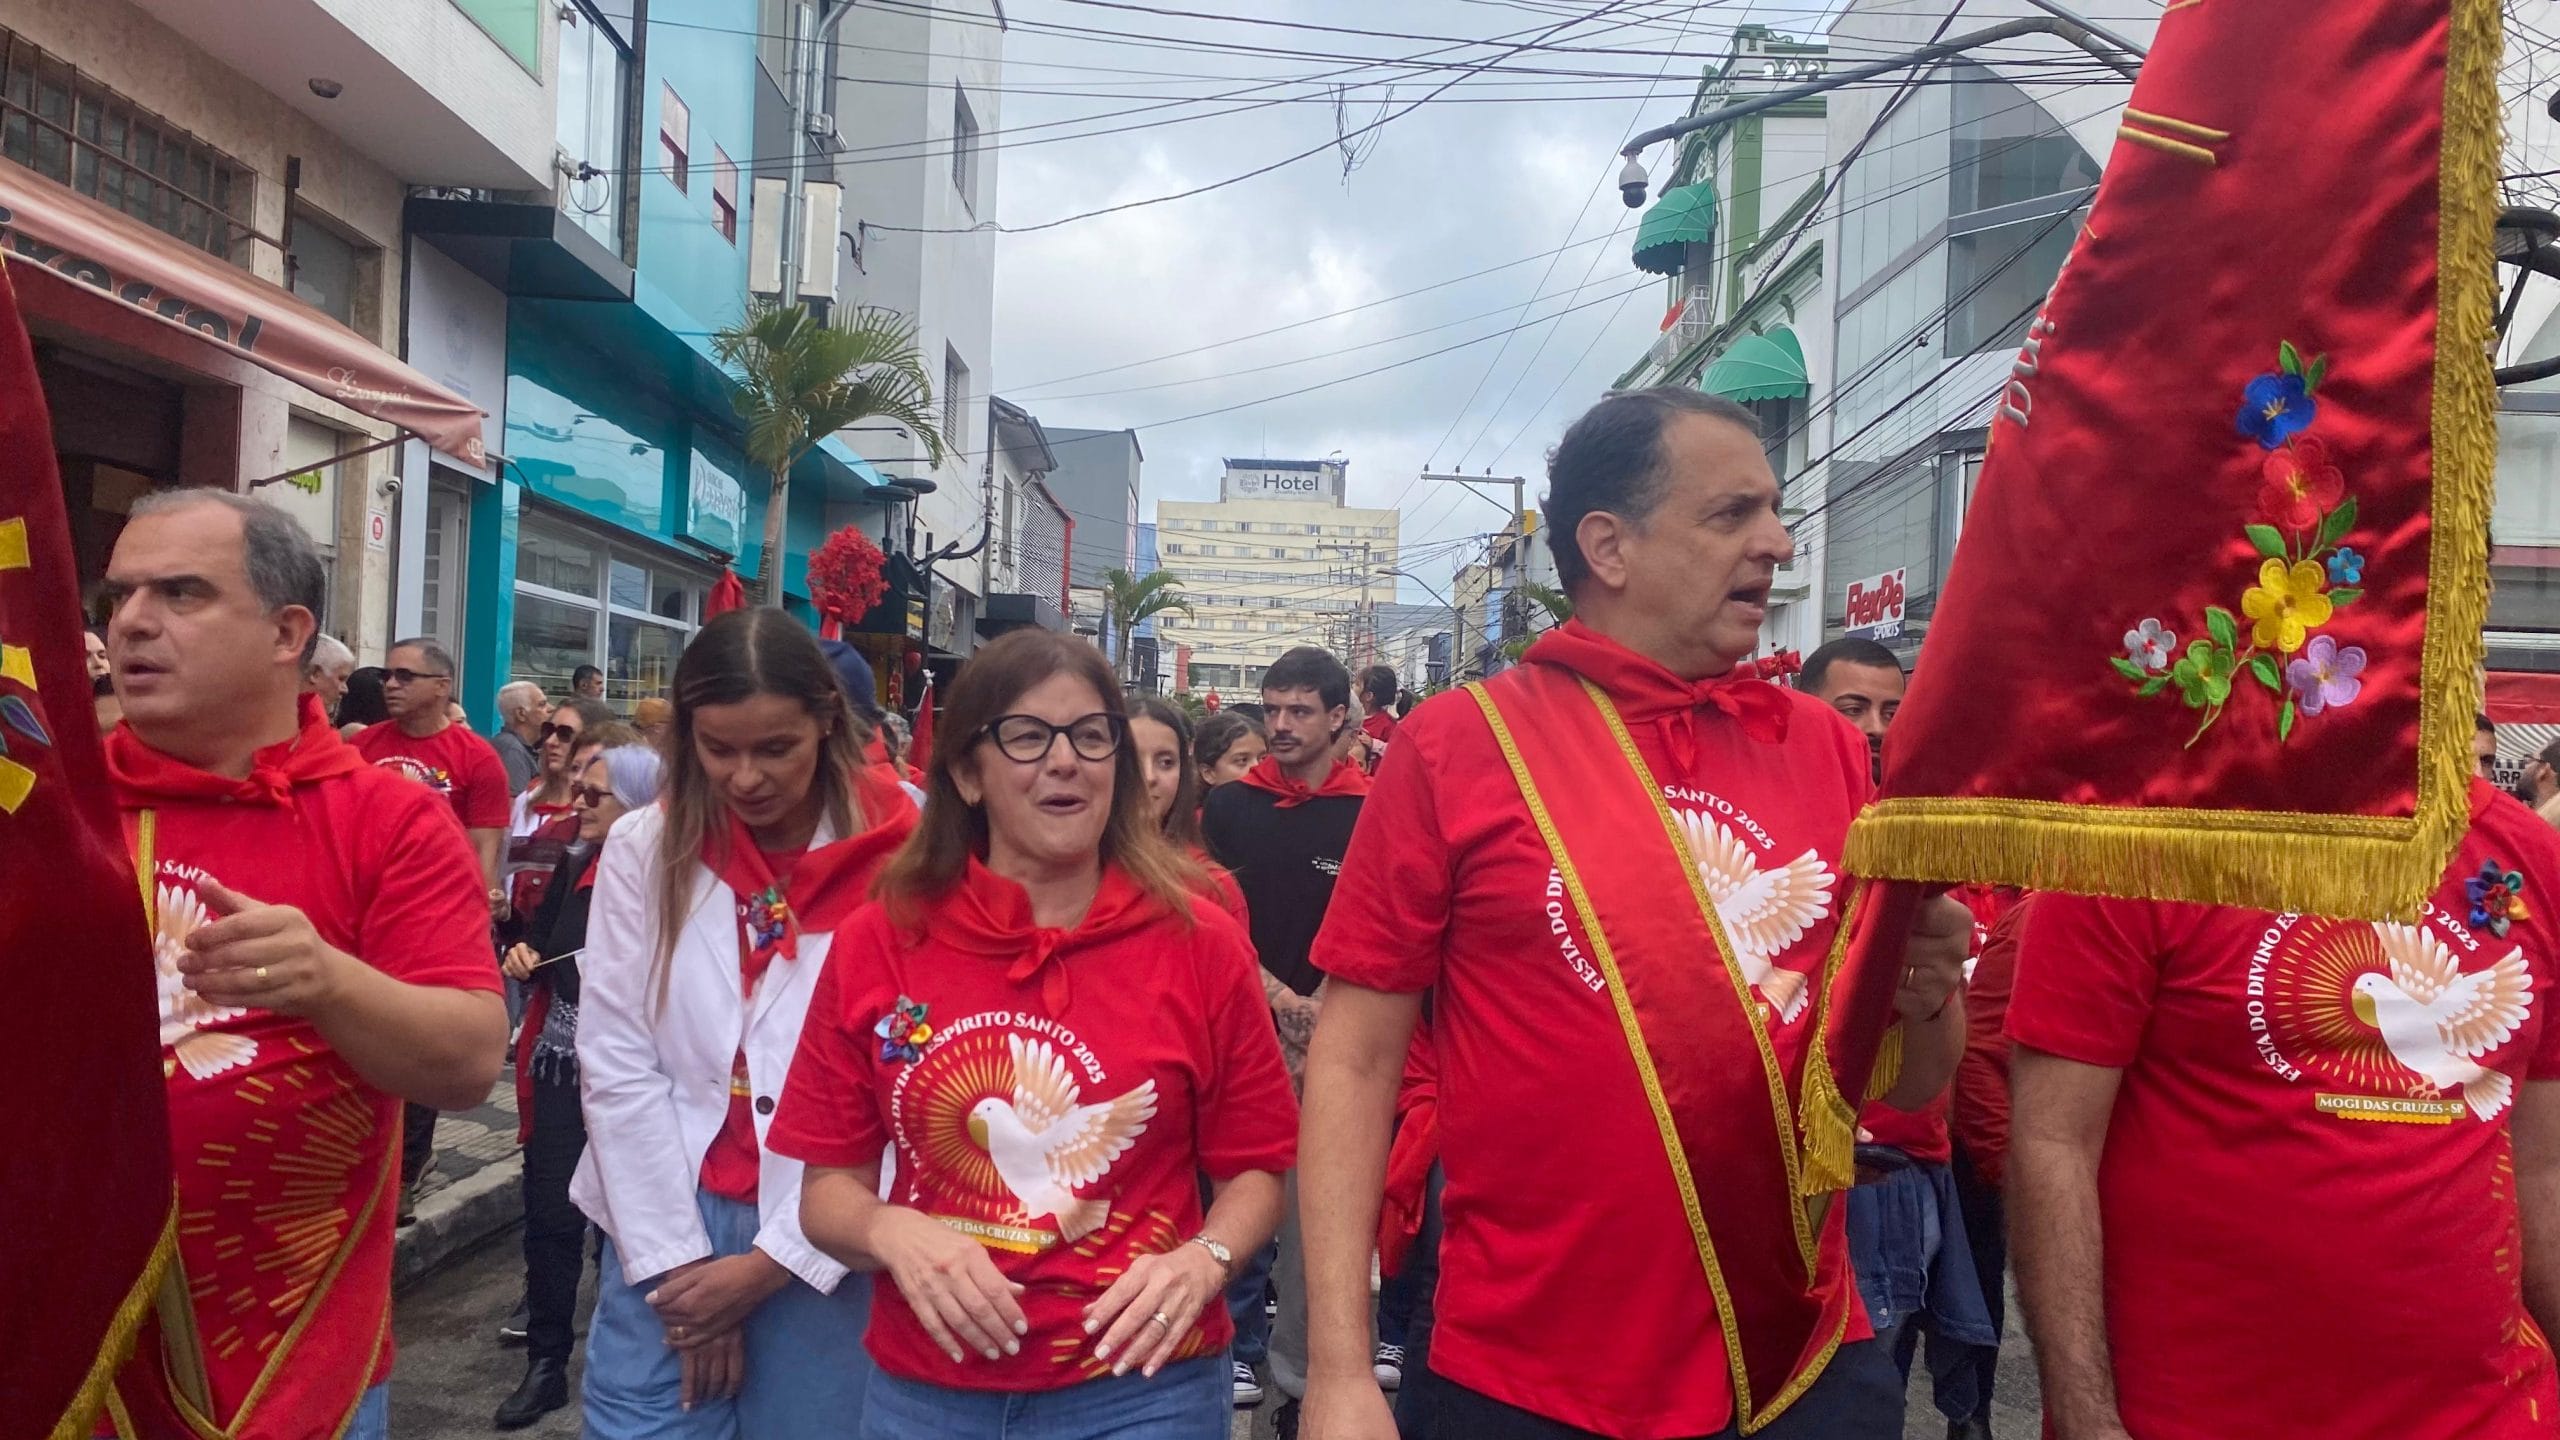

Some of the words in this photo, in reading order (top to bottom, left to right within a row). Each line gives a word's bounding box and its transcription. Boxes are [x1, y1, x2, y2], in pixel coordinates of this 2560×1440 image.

[1263, 473, 1319, 491] Hotel
[1845, 569, 1904, 629] FlexPé
[1872, 621, 1900, 640] SPORTS
[1664, 784, 1734, 815] SANTO
[1734, 809, 1777, 850] 2025
[162, 859, 213, 883] SANT
[1545, 901, 1569, 936] DO
[2436, 910, 2480, 951] 2025
[1560, 934, 1607, 993] FESTA
[2247, 927, 2282, 998] DIVINO
[2247, 1000, 2267, 1032] DO
[1013, 1011, 1076, 1047] SANTO
[1071, 1041, 1107, 1085] 2025
[2256, 1032, 2302, 1082] FESTA
[2319, 1097, 2360, 1110] MOGI
[2362, 1100, 2390, 1111] DAS
[2392, 1102, 2443, 1114] CRUZES
[2450, 1103, 2464, 1114] SP
[964, 1222, 985, 1234] DAS
[986, 1226, 1031, 1242] CRUZES
[1041, 1233, 1057, 1244] SP
